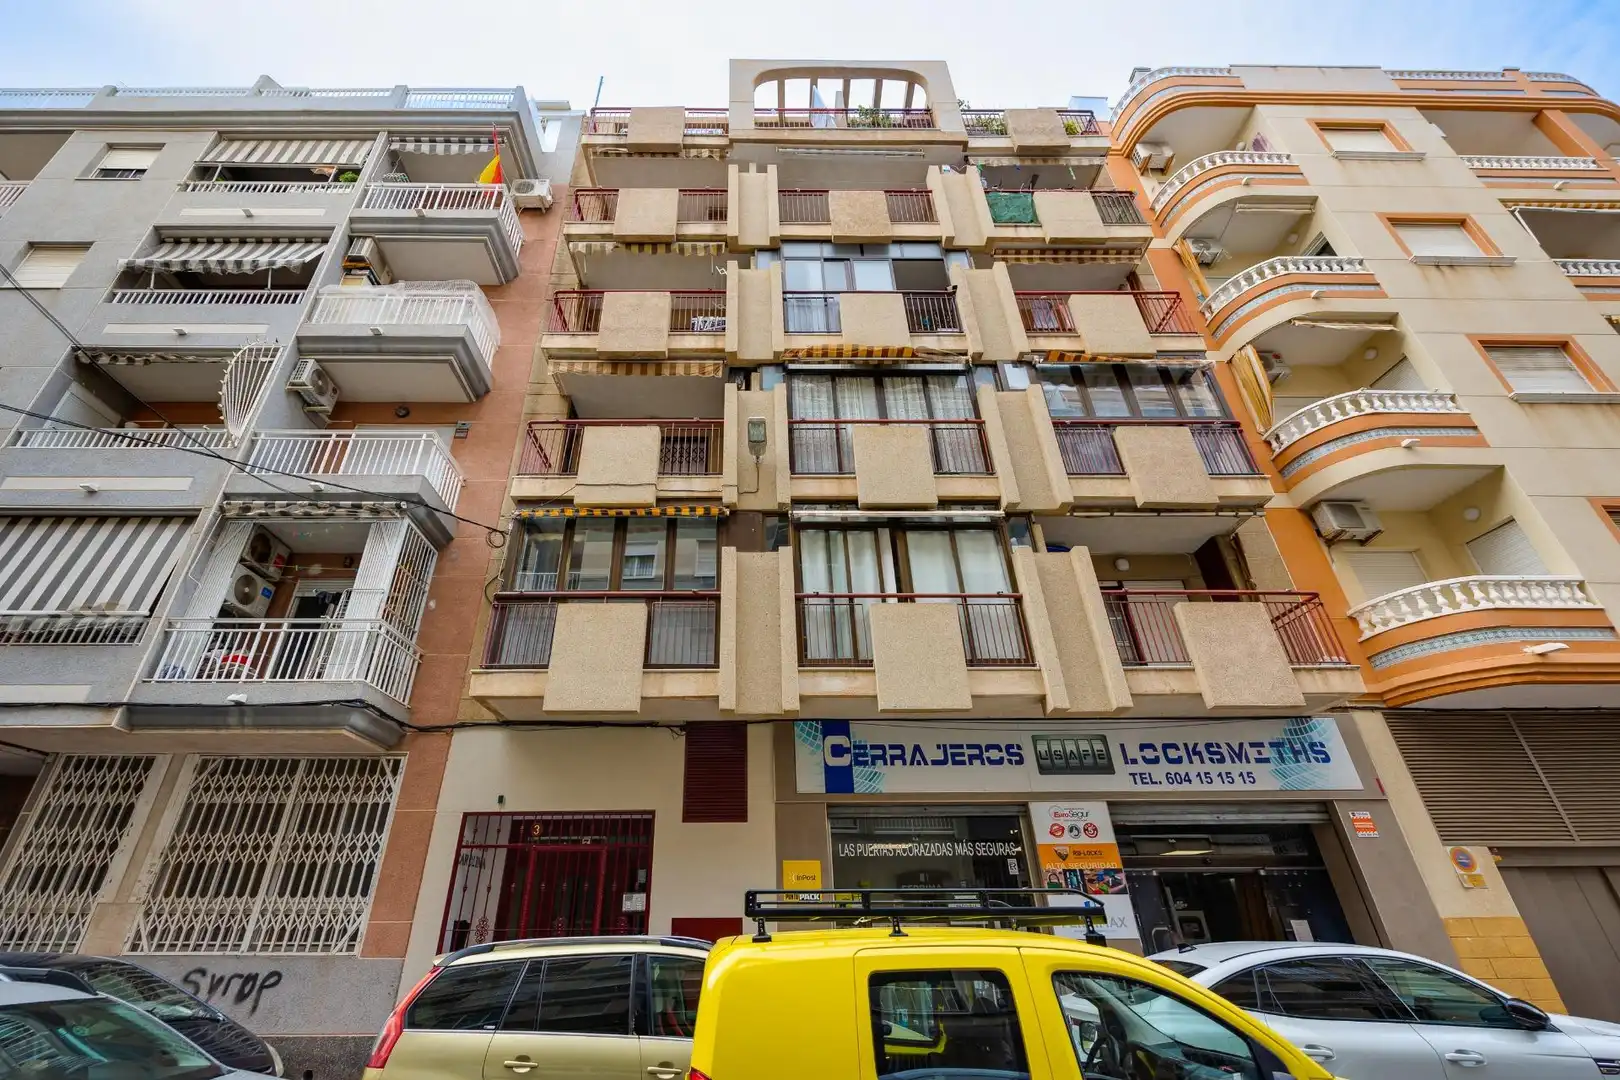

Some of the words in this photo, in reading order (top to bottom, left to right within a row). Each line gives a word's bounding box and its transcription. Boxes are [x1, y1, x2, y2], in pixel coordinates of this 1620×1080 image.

[823, 735, 1025, 767] CERRAJEROS
[1039, 749, 1106, 761] USAFE
[1119, 741, 1332, 765] LOCKSMITHS
[1129, 772, 1163, 785] TEL.
[1165, 772, 1193, 785] 604
[1196, 772, 1214, 785] 15
[1217, 772, 1235, 785] 15
[1238, 772, 1256, 785] 15
[533, 824, 540, 835] 3
[838, 843, 855, 857] LAS
[856, 843, 894, 857] PUERTAS
[895, 843, 954, 857] ACORAZADAS
[955, 839, 974, 857] MÁS
[975, 842, 1017, 857] SEGURAS
